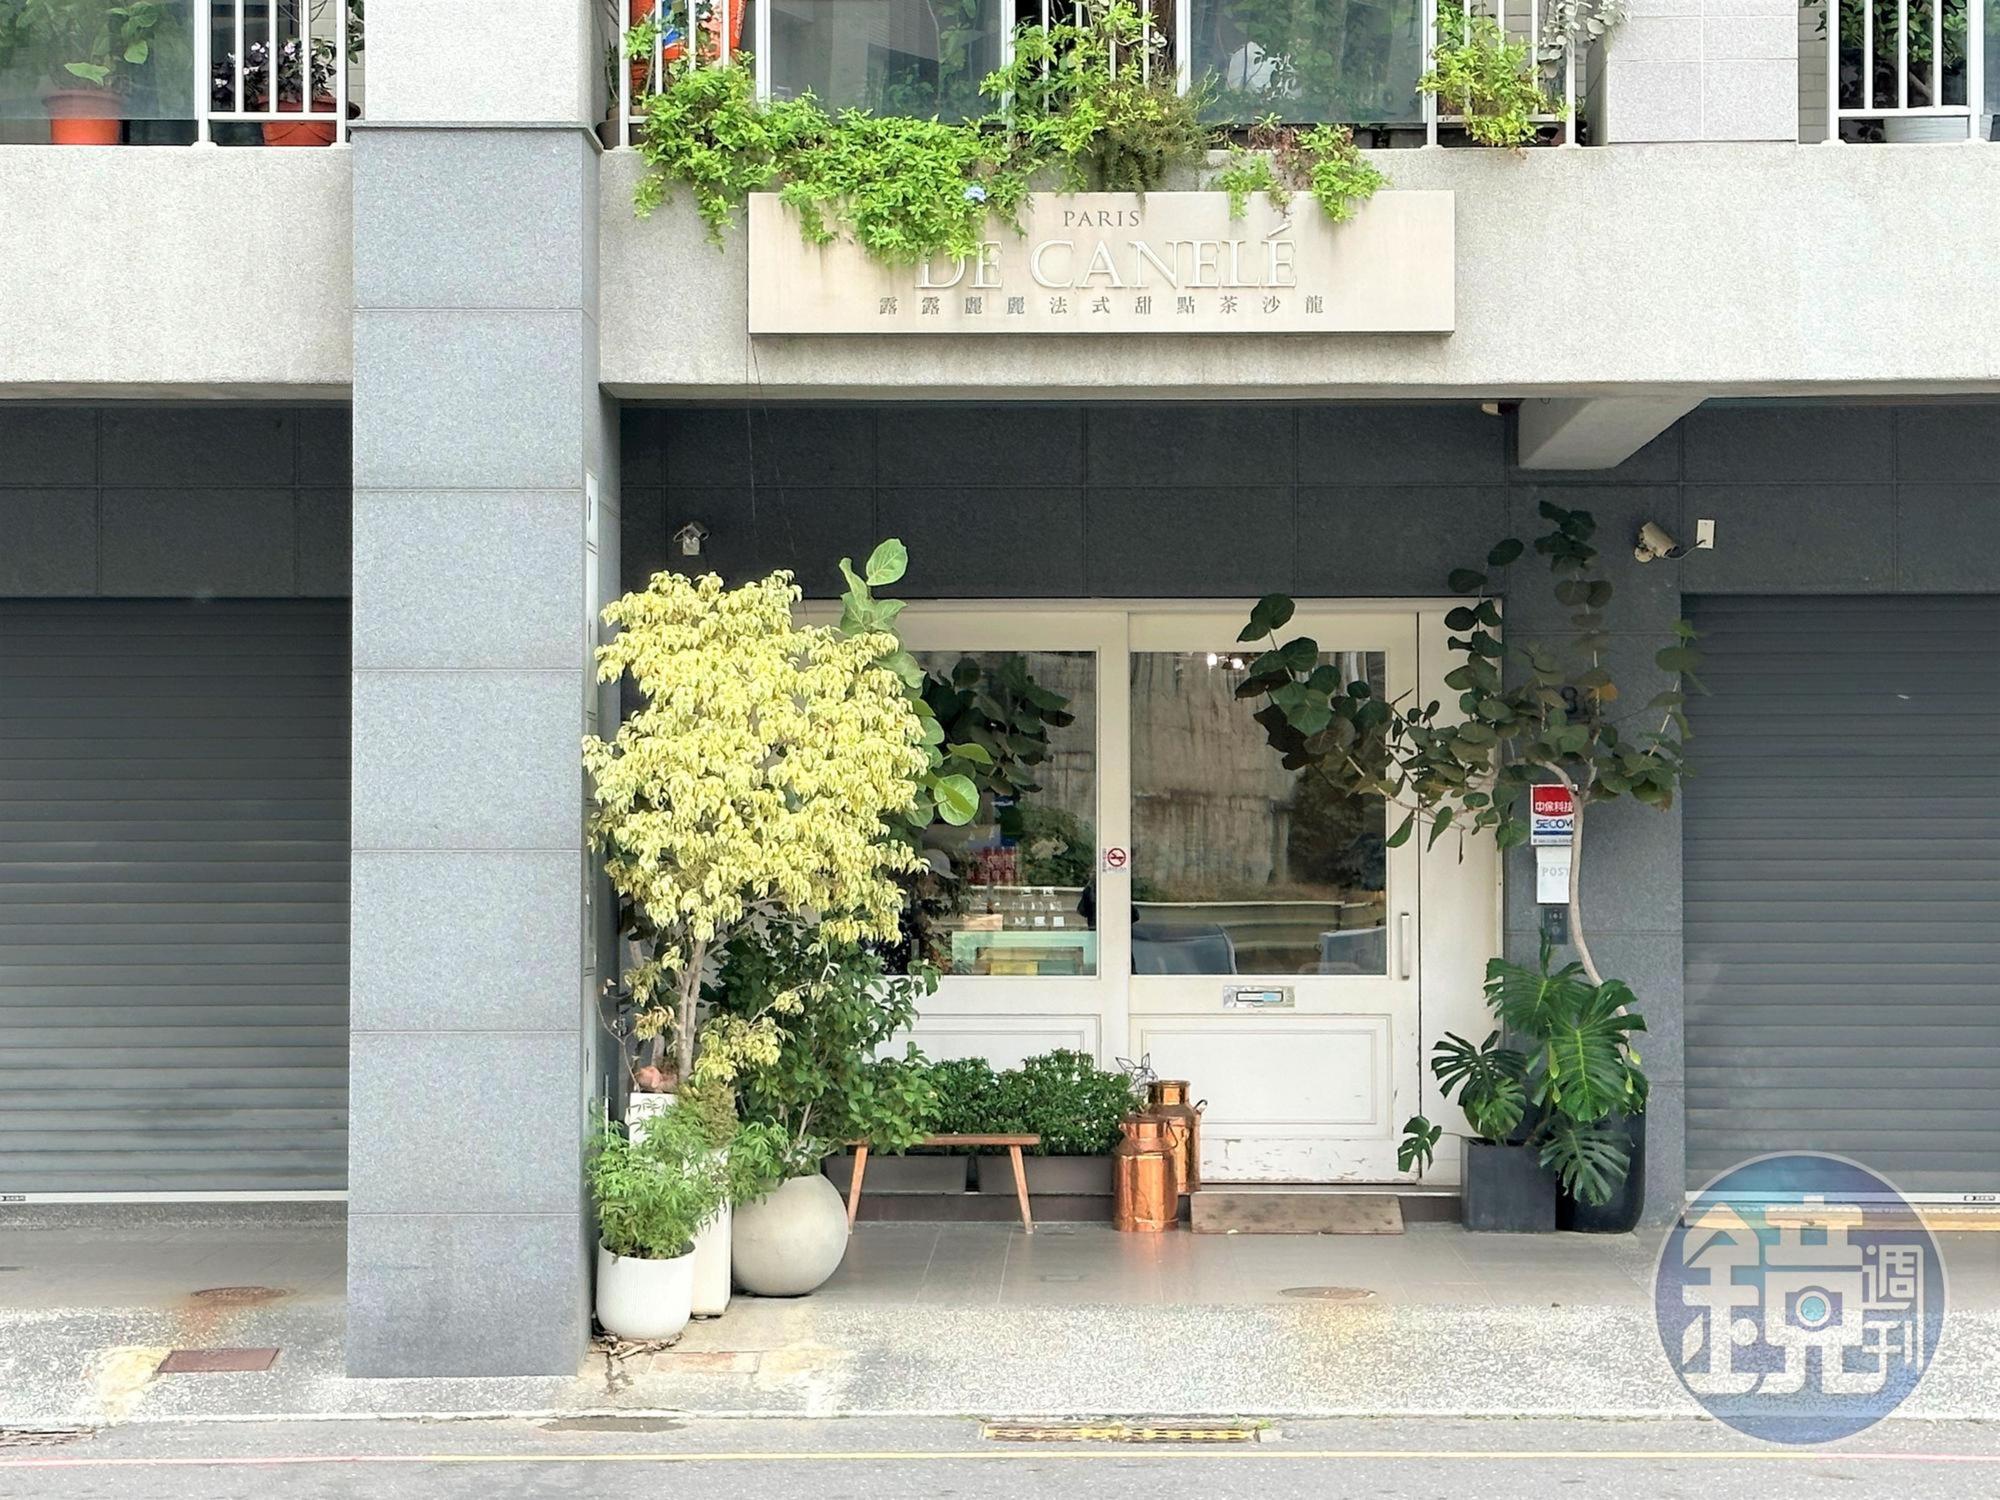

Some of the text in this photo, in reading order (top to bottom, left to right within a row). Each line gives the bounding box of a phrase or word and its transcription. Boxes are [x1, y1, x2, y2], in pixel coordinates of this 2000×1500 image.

[1063, 210, 1141, 228] PARIS
[914, 220, 1298, 290] DE CANELÉ
[878, 295, 1325, 316] 露露麗麗法式甜點茶沙龍
[1535, 818, 1573, 829] SECOM
